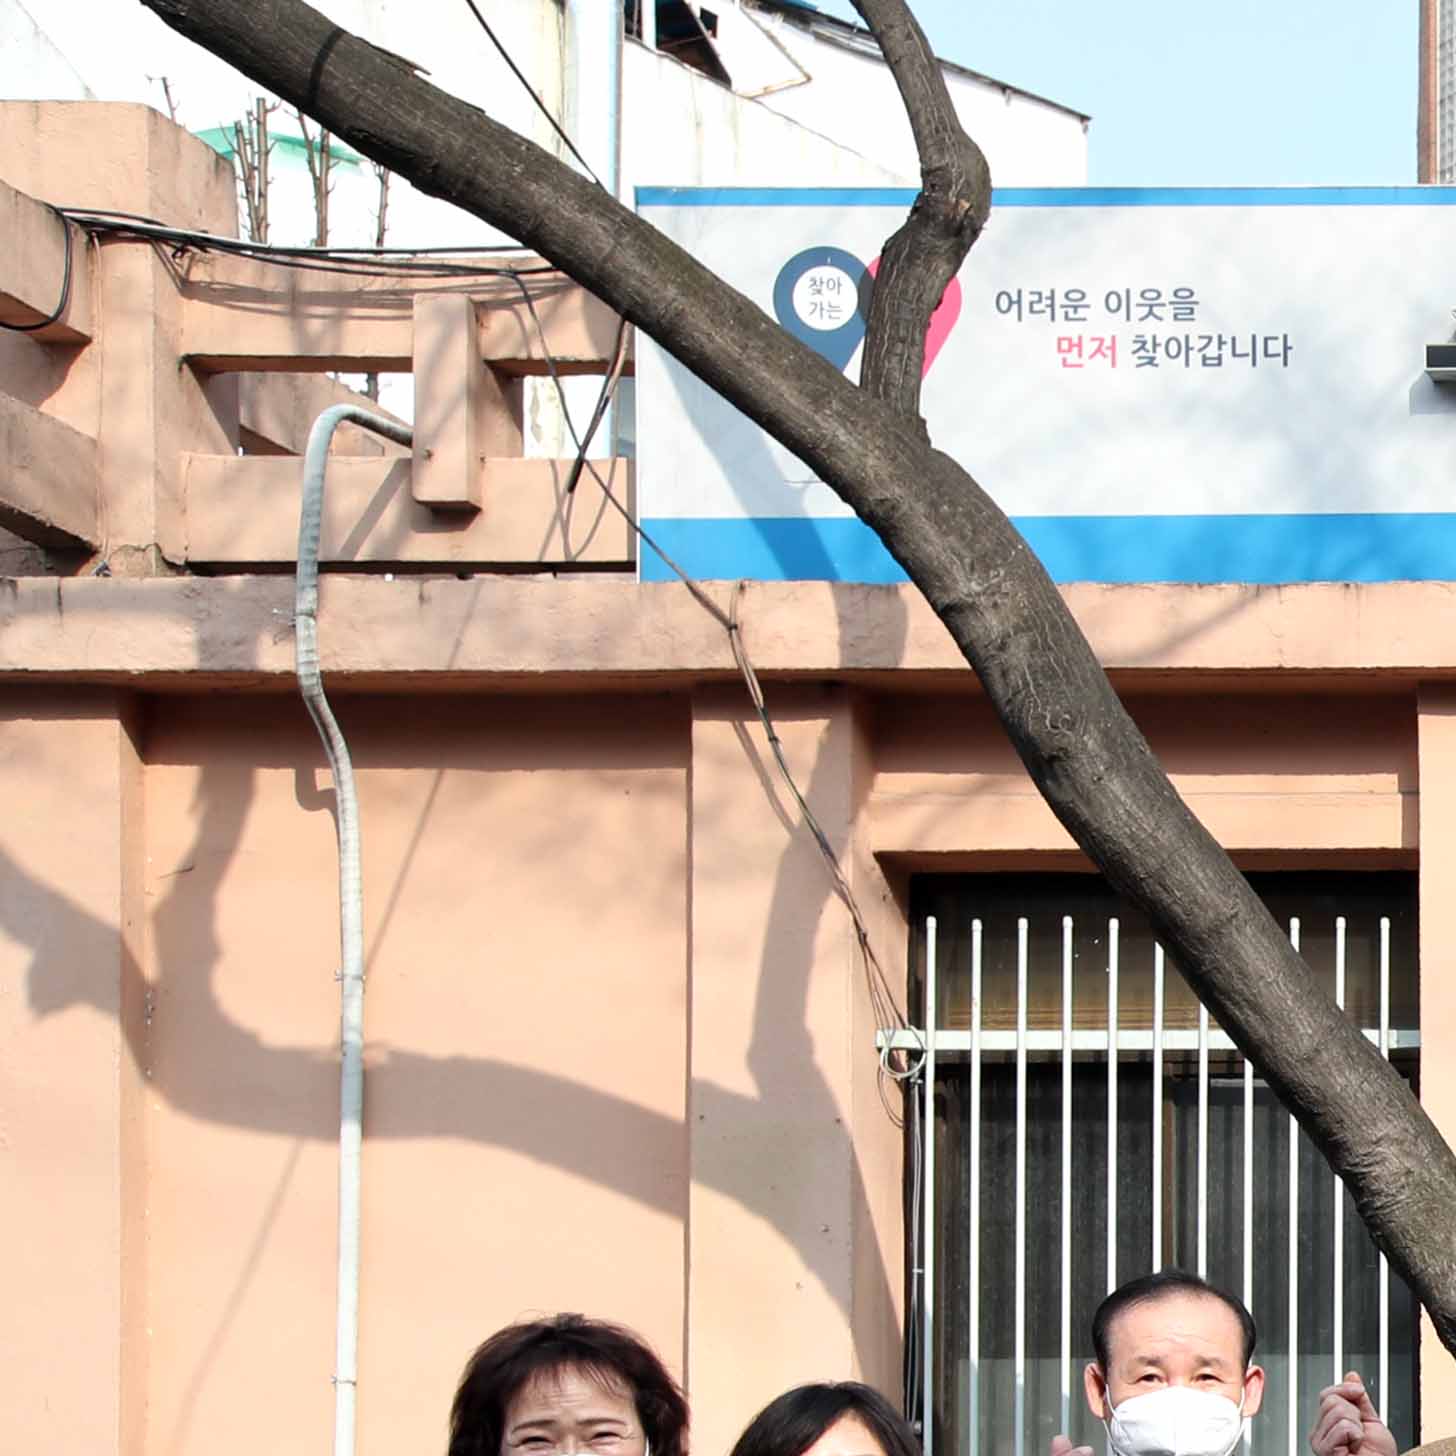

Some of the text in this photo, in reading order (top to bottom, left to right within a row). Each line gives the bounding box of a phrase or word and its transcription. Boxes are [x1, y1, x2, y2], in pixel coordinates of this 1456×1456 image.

[808, 276, 843, 296] 찾아
[808, 300, 843, 320] 가는
[995, 287, 1200, 323] 어려운 이웃을
[1056, 333, 1294, 368] 먼저 찾아갑니다
